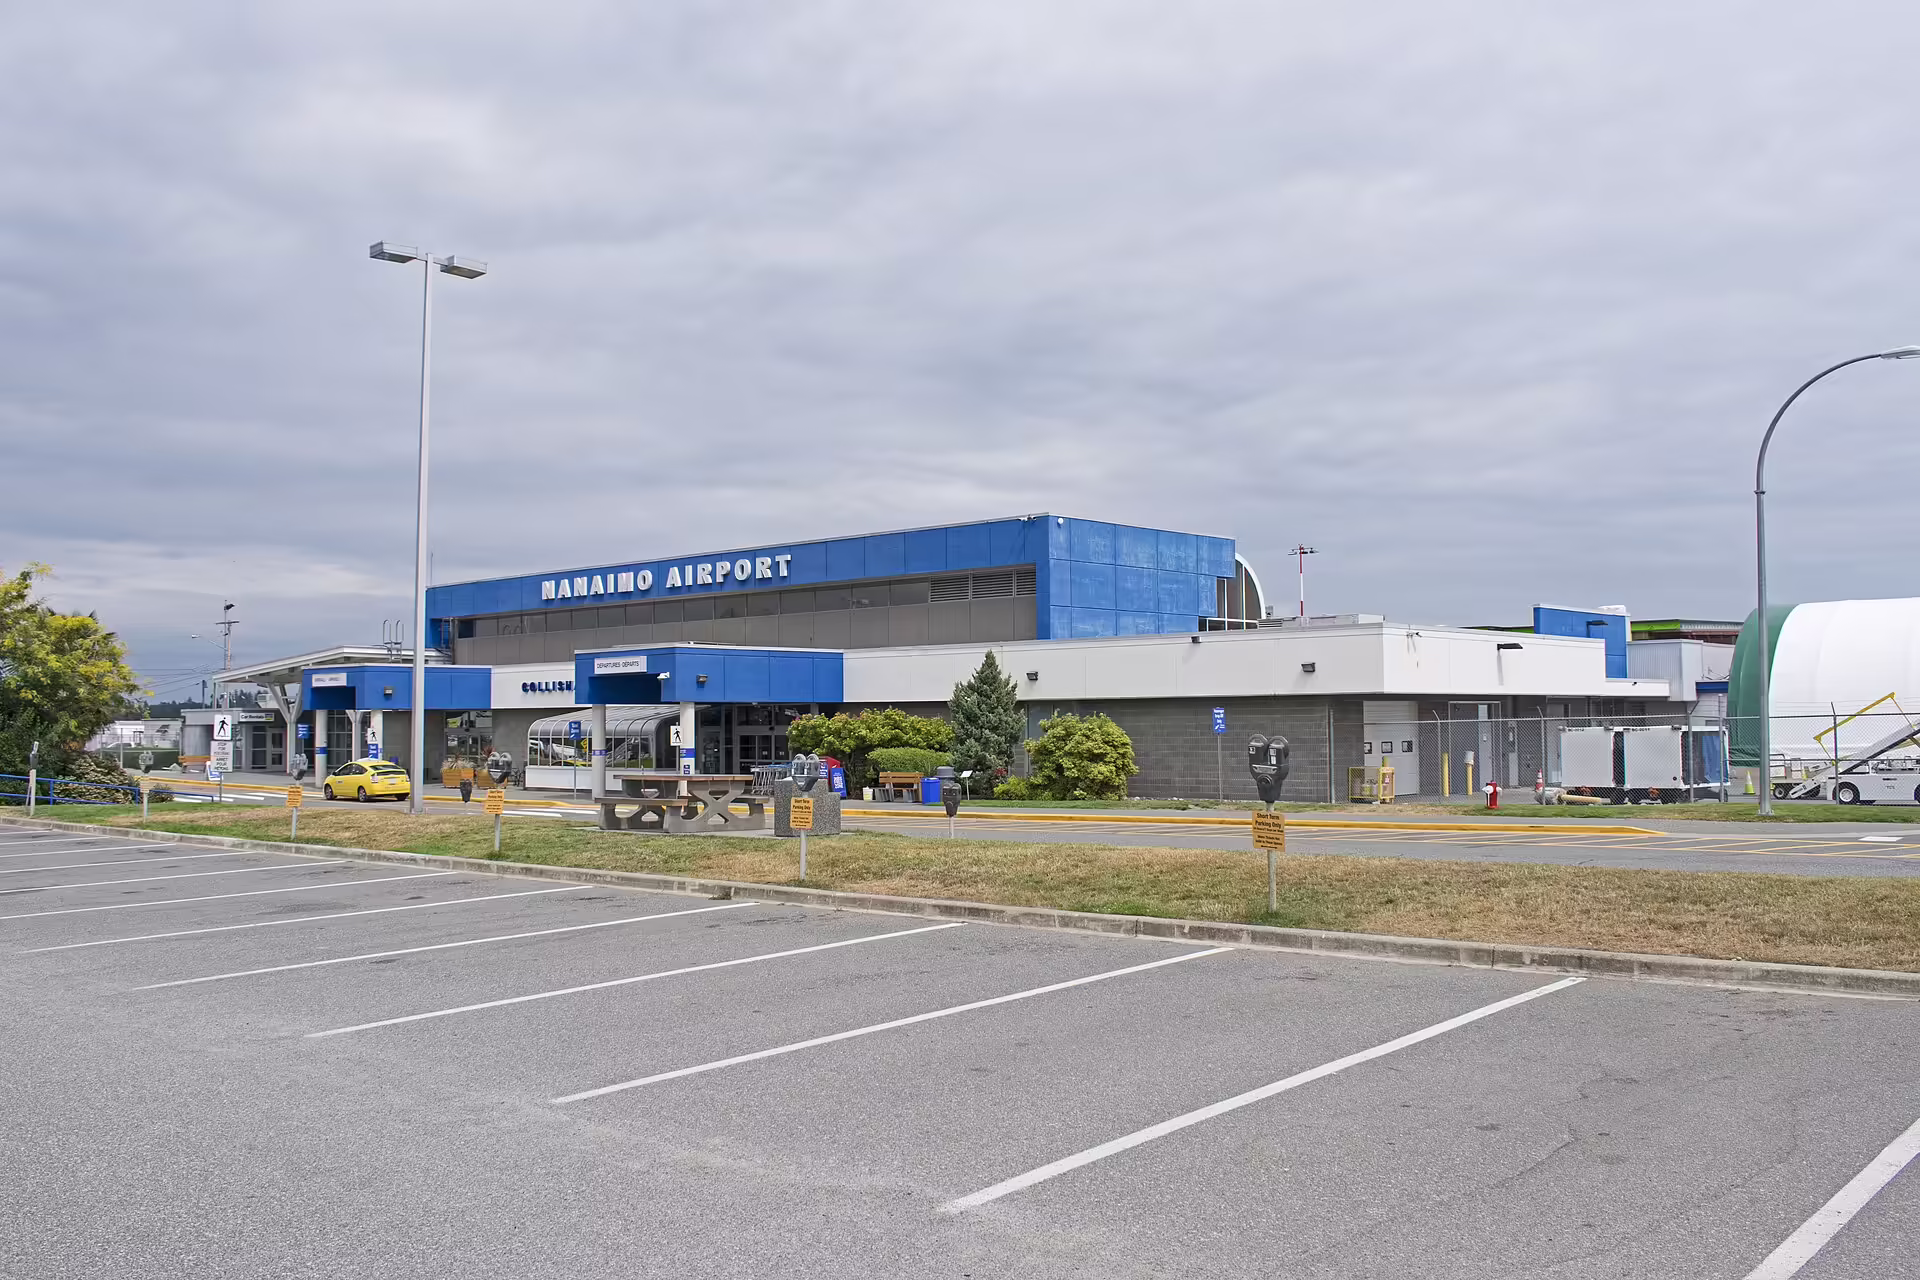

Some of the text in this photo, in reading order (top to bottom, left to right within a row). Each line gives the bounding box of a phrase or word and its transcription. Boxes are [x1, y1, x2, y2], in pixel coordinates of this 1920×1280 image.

[541, 554, 792, 600] NANAIMO AIRPORT
[596, 661, 621, 669] DEPARTURES
[521, 680, 575, 692] COLLISH
[1255, 820, 1272, 828] Parking
